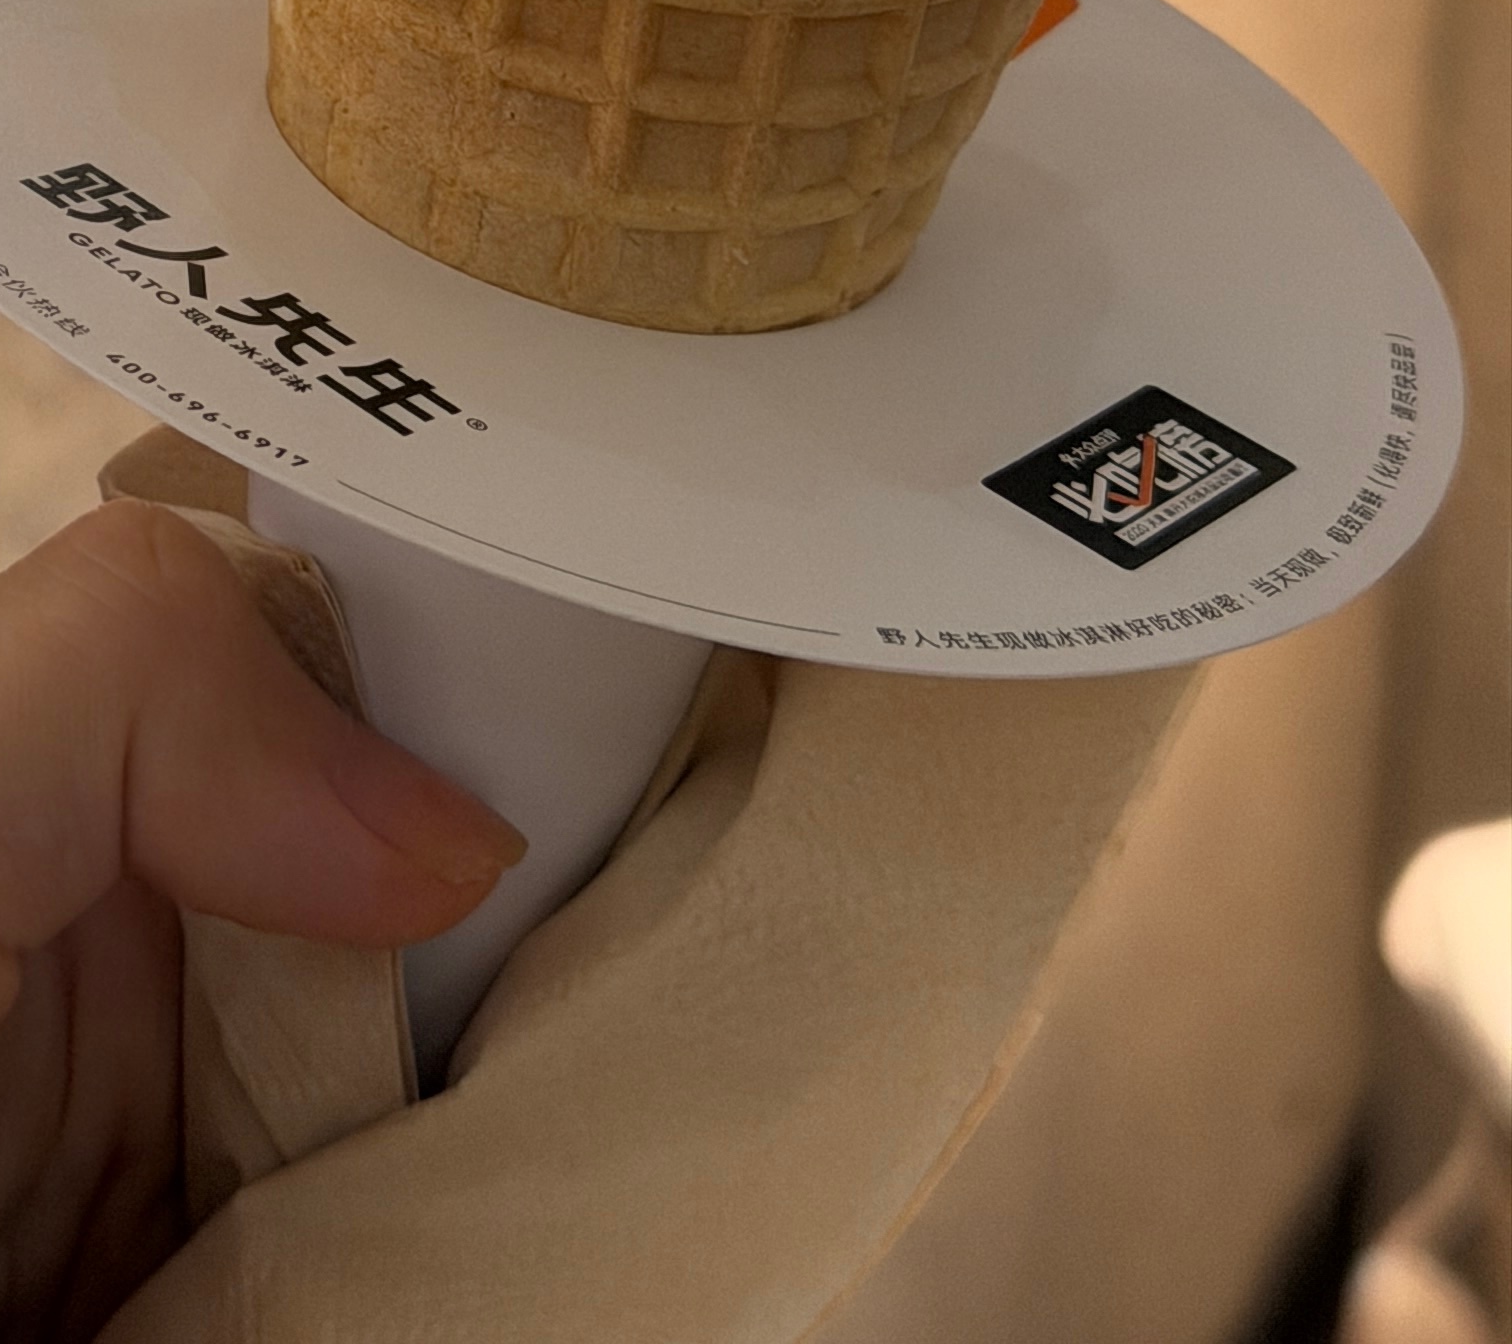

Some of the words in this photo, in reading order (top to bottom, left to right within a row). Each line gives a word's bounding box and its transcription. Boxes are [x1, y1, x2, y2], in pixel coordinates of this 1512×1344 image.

[19, 162, 462, 437] 野人先生
[104, 352, 311, 468] 400-696-6917
[1048, 417, 1236, 525] 必吃榜
